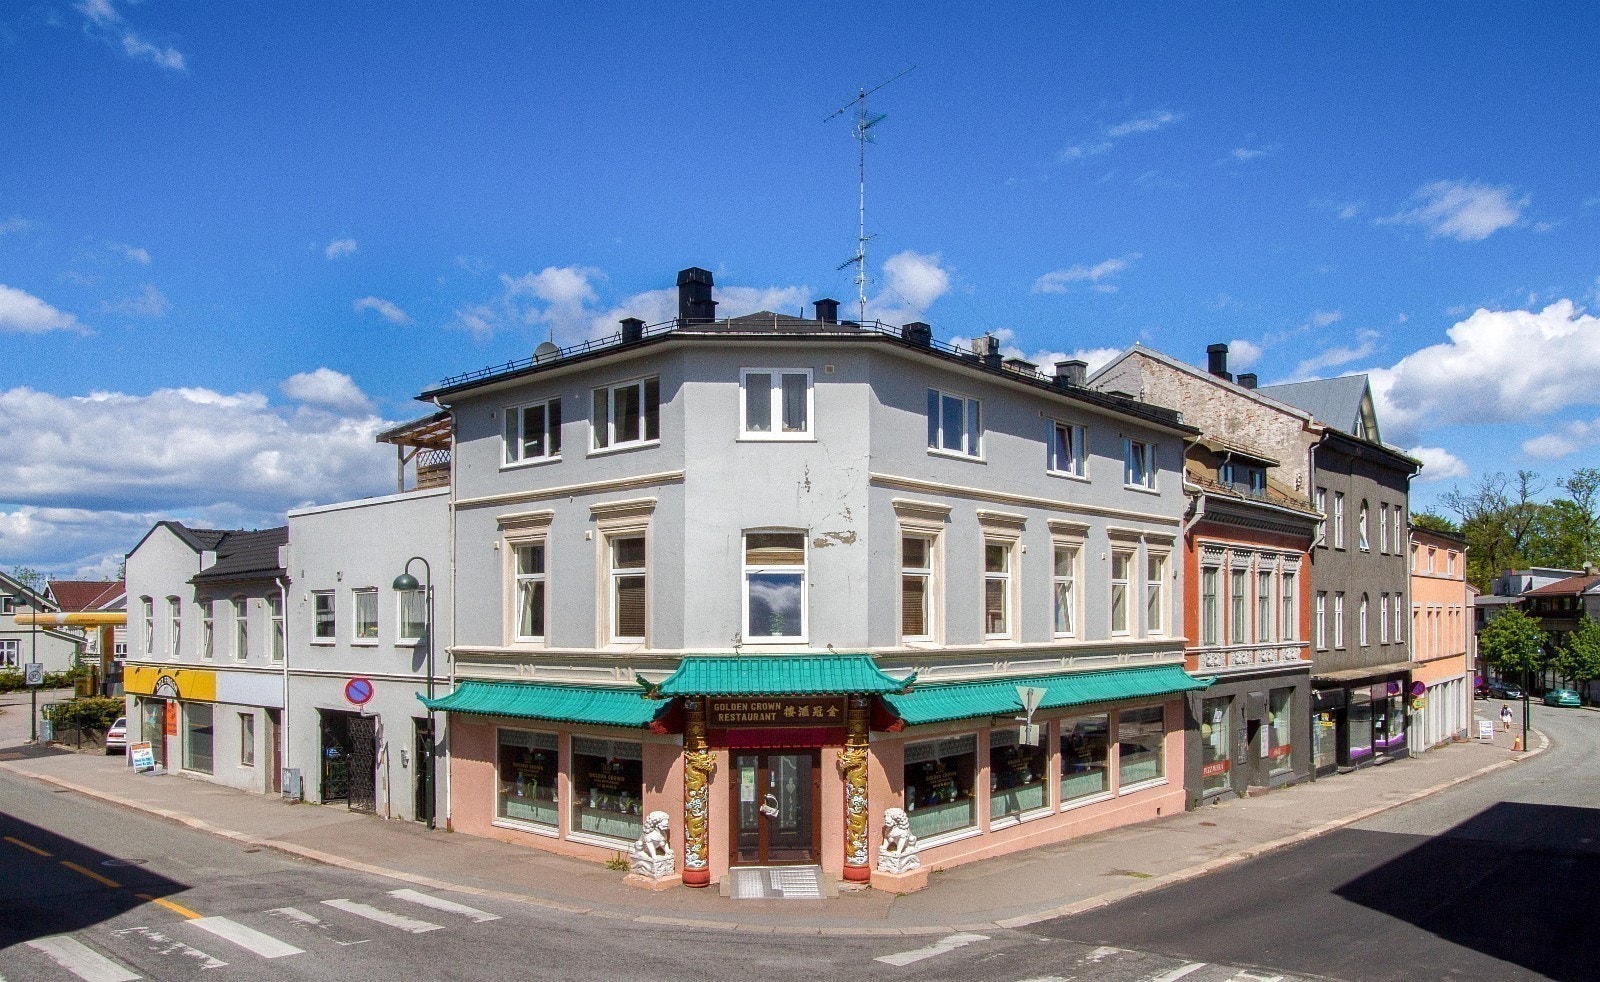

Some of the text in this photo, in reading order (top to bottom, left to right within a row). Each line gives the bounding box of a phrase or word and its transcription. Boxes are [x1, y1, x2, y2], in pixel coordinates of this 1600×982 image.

[714, 702, 781, 711] GOLDEN CROWN
[718, 712, 776, 722] RESTAURANT
